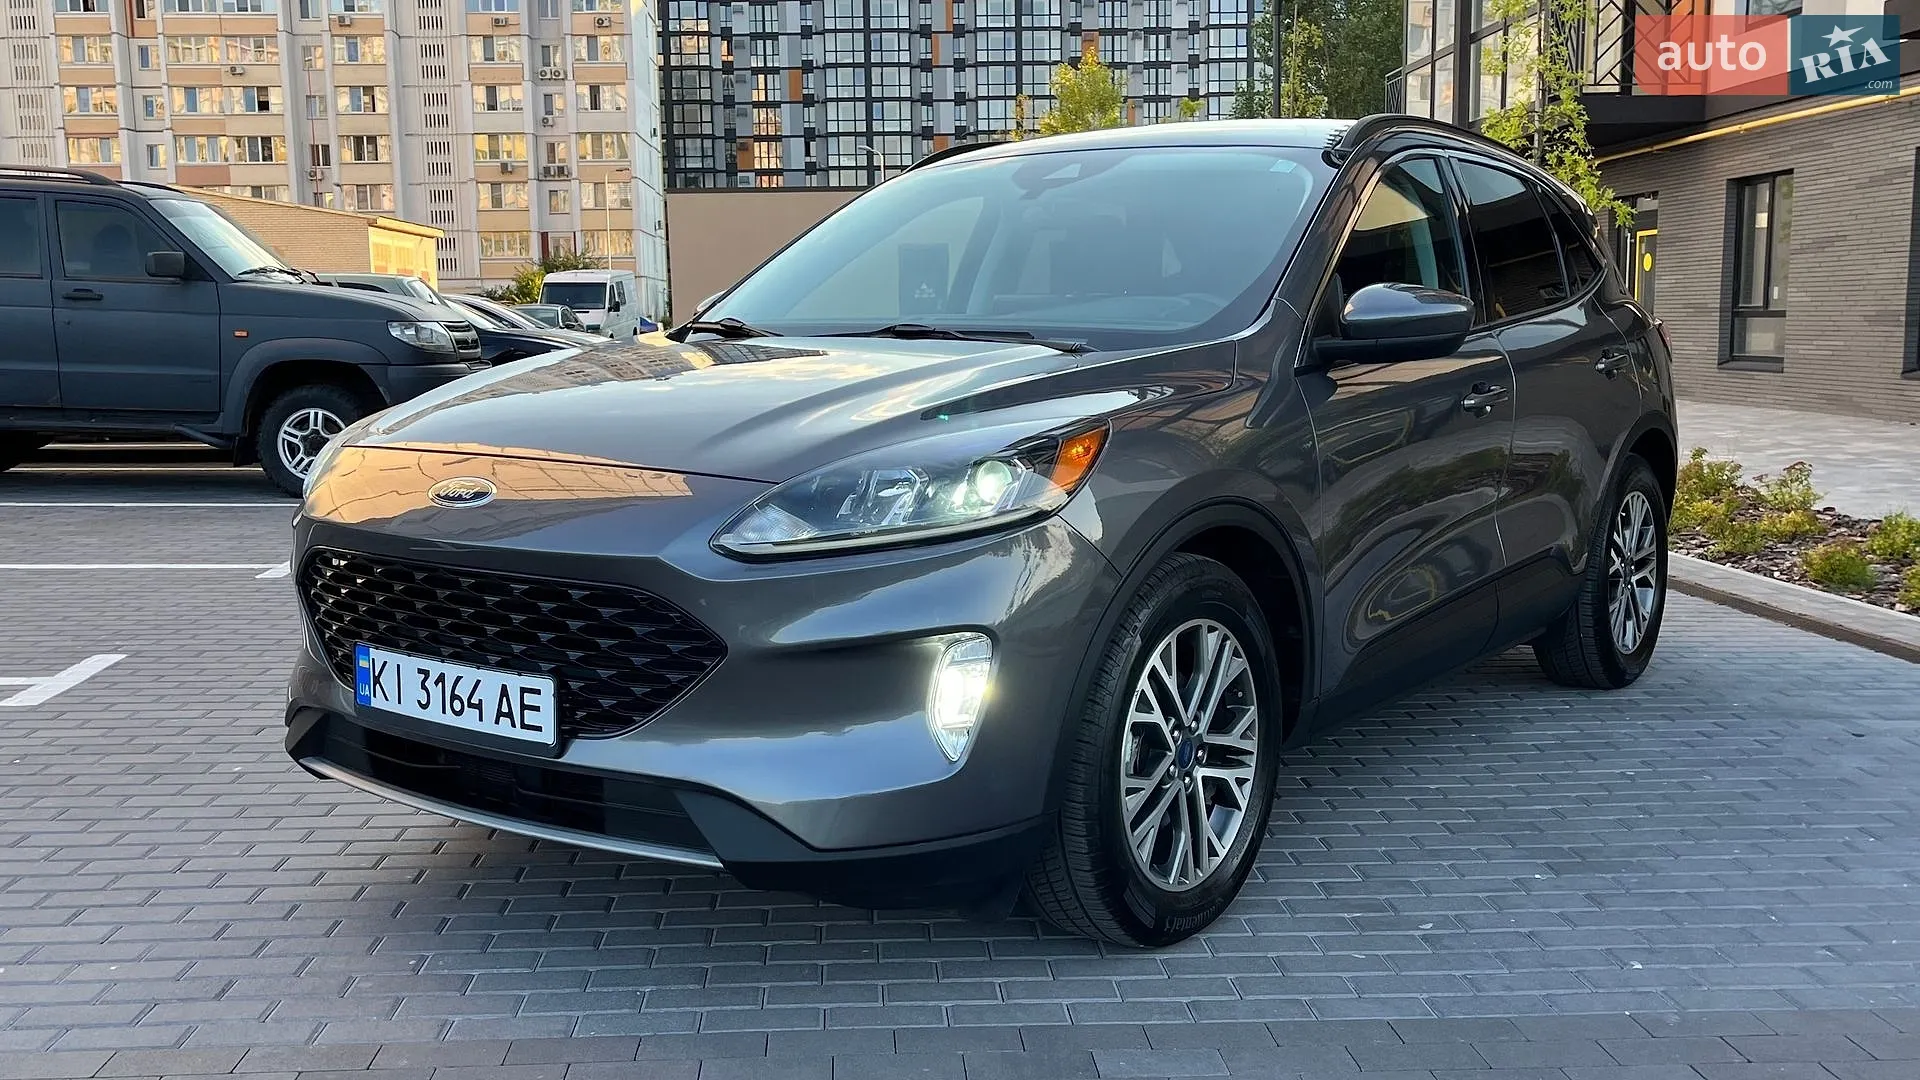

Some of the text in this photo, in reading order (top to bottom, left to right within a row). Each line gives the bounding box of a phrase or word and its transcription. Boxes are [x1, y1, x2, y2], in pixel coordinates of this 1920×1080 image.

[439, 480, 481, 499] Ford
[359, 684, 370, 696] UA
[371, 657, 543, 732] KI 3164 AE
